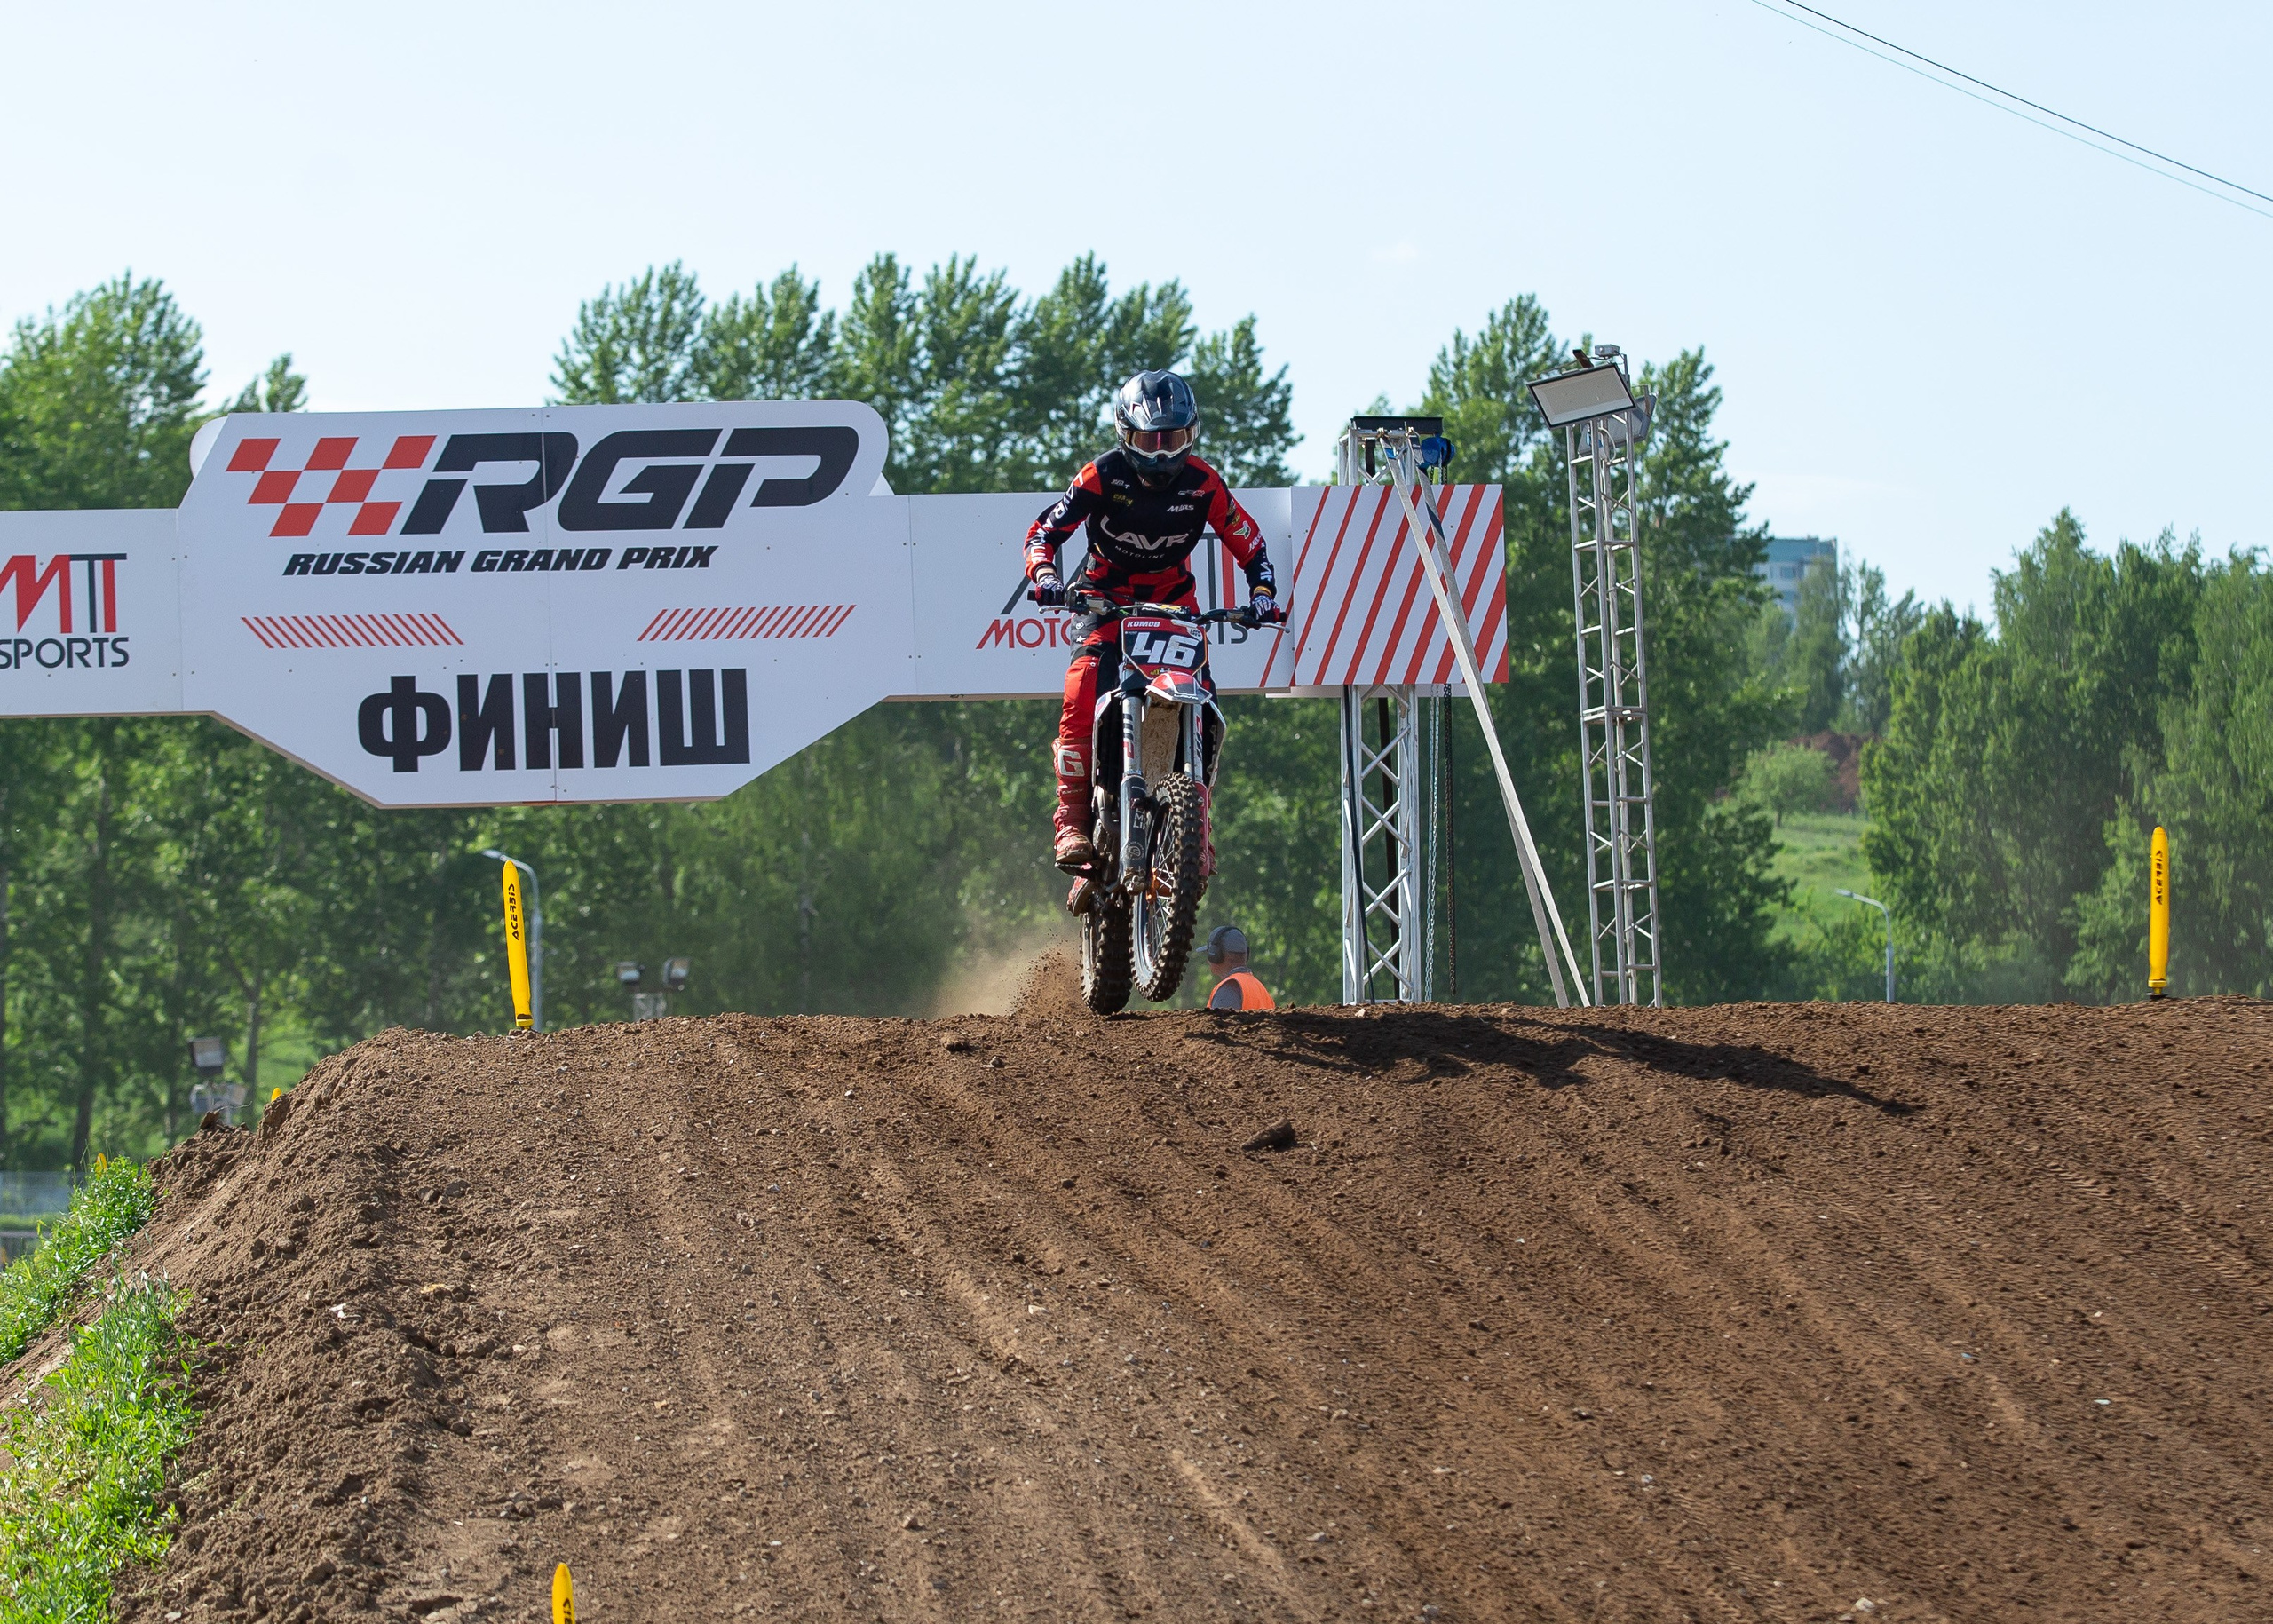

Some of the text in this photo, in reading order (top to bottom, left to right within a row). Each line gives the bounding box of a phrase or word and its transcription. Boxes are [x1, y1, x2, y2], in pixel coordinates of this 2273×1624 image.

[400, 426, 859, 535] RGP
[282, 546, 718, 575] RUSSIAN GRAND PRIX
[1114, 545, 1165, 558] MOTOLINE
[1131, 631, 1200, 667] 46
[358, 669, 750, 772] ФИНИШ
